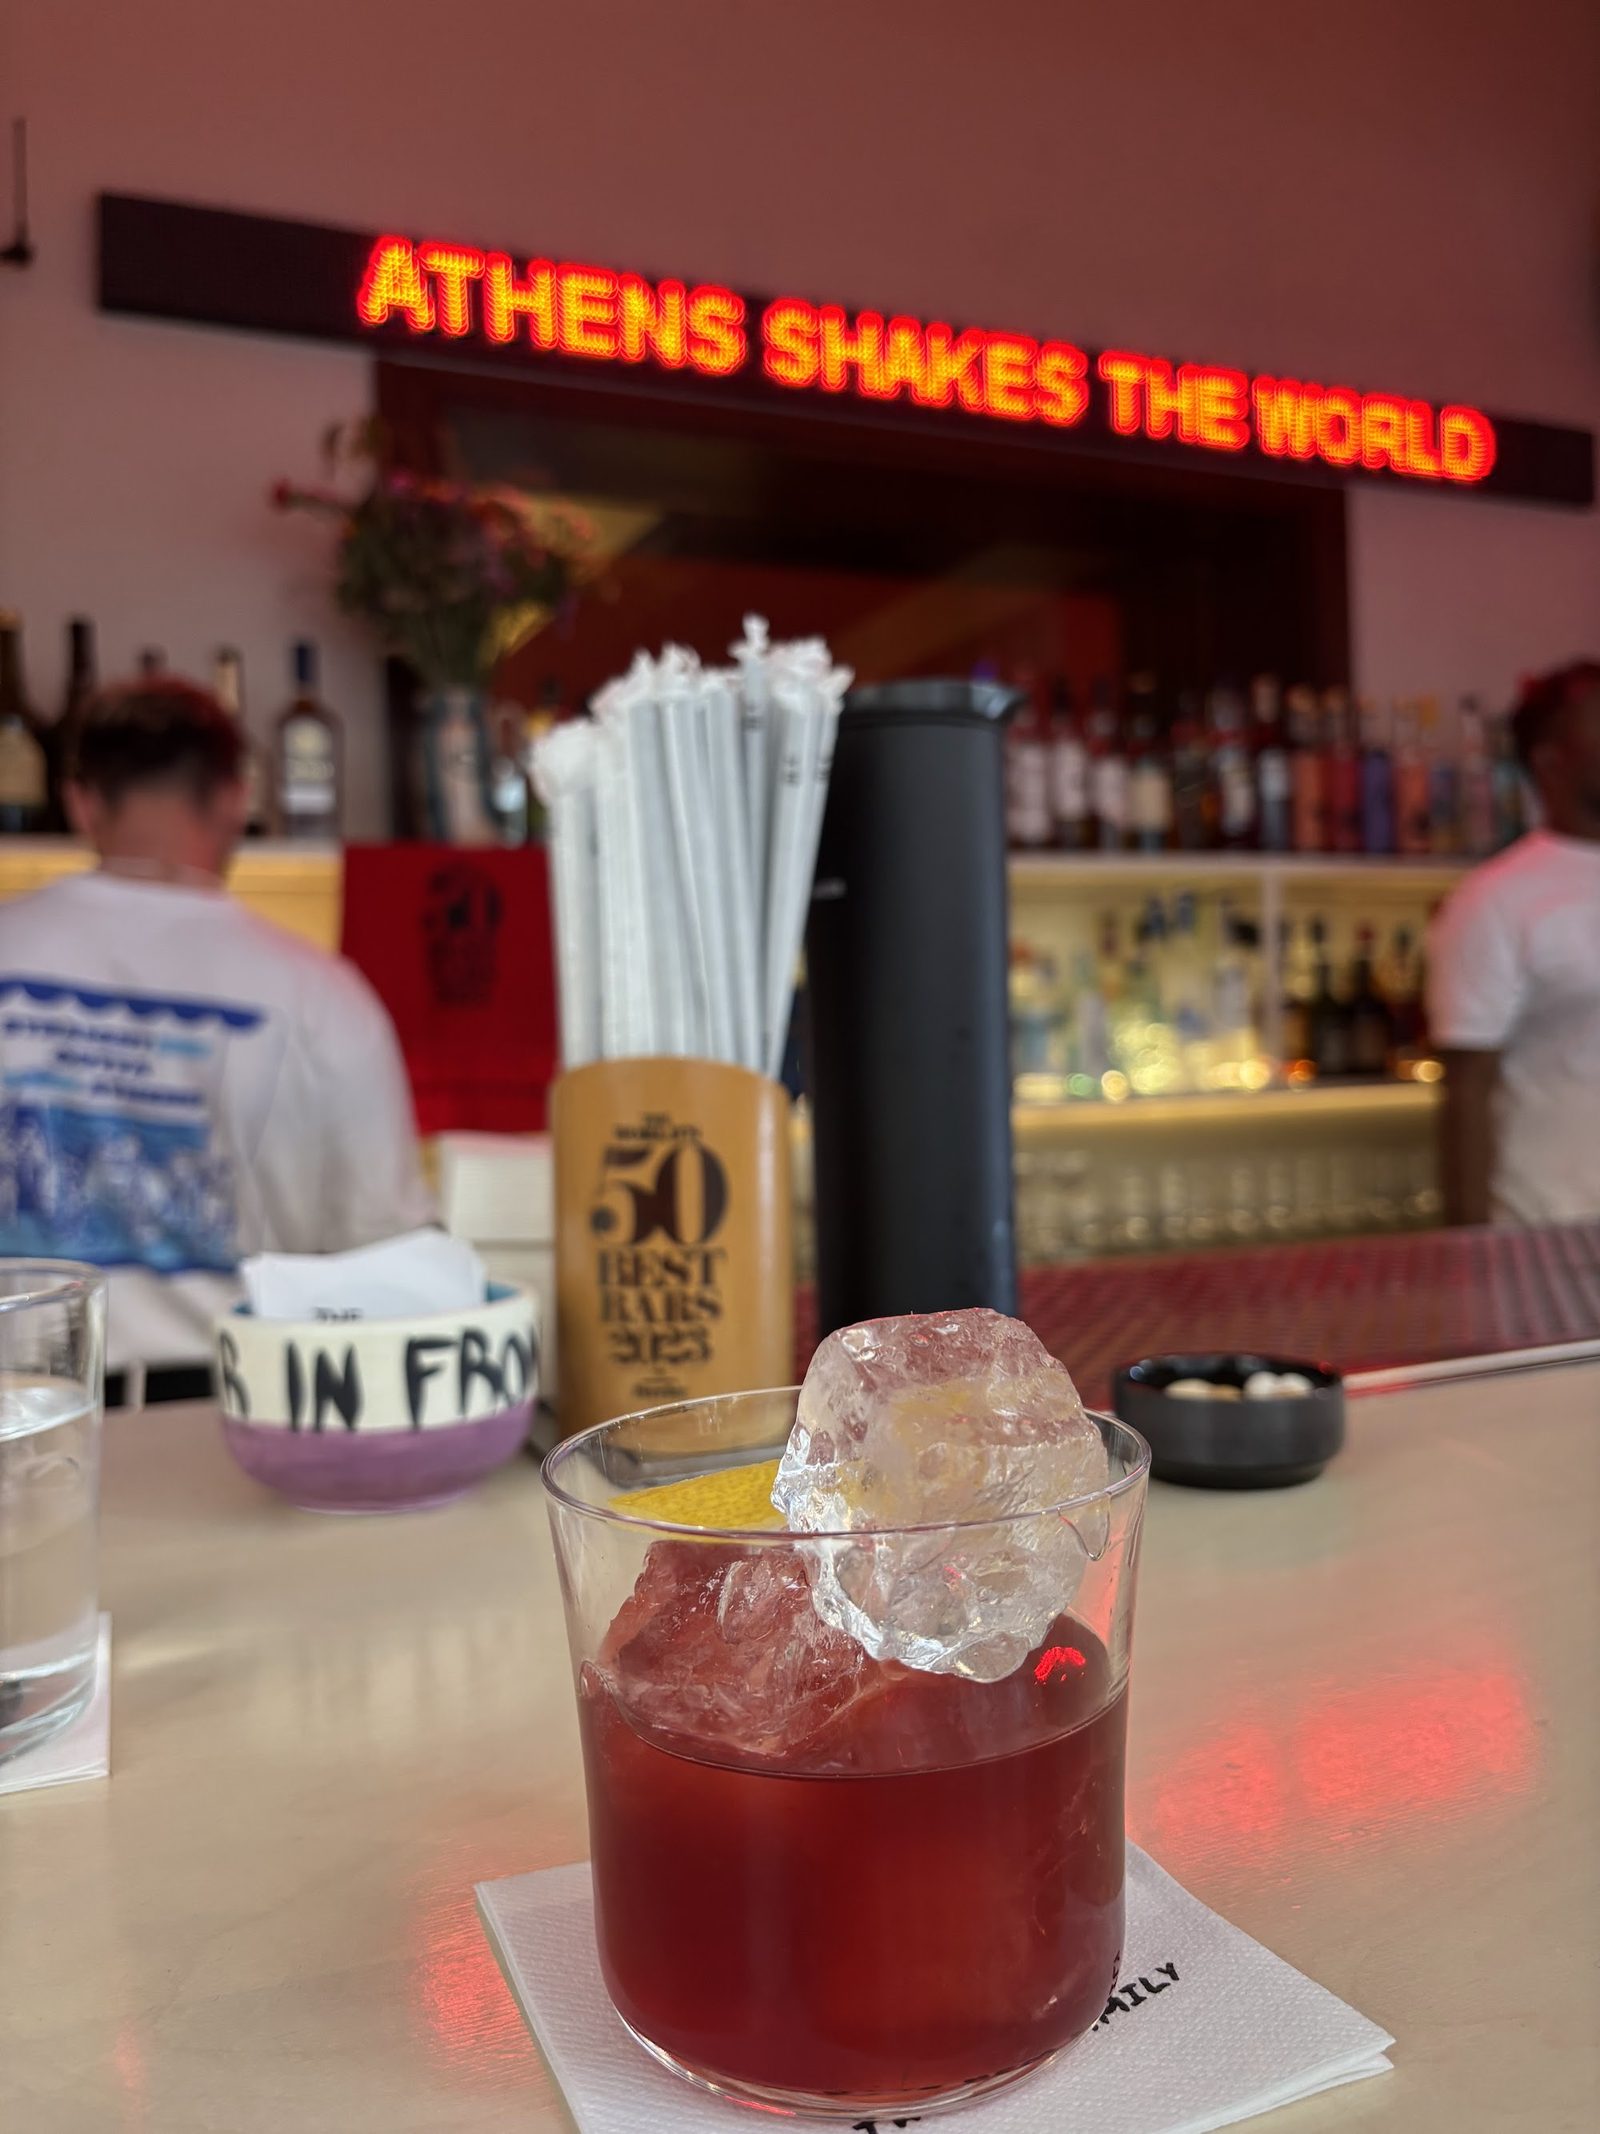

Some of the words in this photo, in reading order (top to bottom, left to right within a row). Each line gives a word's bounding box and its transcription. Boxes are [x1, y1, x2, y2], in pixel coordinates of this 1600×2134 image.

[357, 234, 747, 375] ATHENS
[762, 297, 1089, 426] SHAKES
[1098, 351, 1249, 452] THE
[1252, 374, 1497, 482] WORLD
[590, 1142, 728, 1246] 50
[599, 1247, 727, 1287] BEST
[601, 1288, 721, 1323] BARS
[286, 1337, 362, 1433] IN
[1093, 1962, 1180, 2032] MILY
